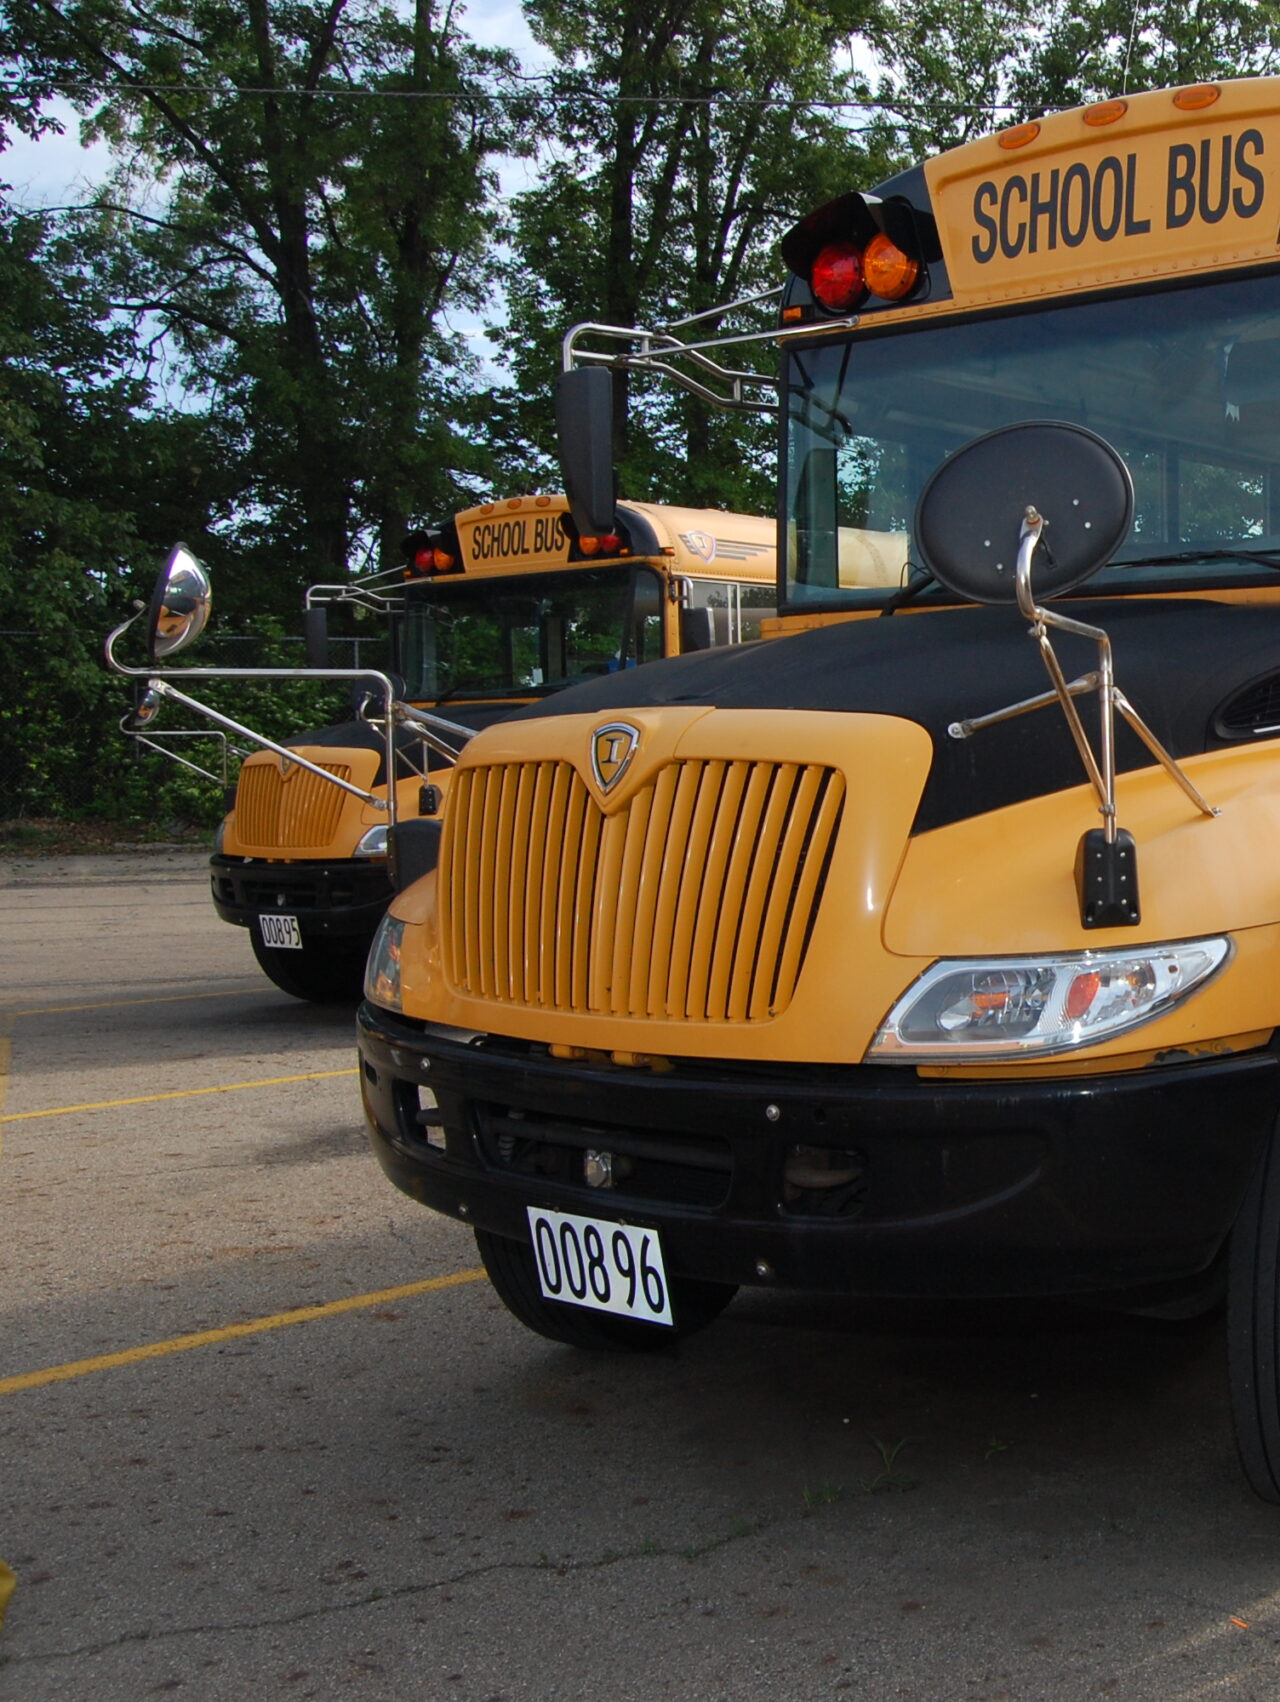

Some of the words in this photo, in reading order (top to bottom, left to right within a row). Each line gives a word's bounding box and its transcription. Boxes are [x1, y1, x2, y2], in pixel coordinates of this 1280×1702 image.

[971, 152, 1151, 264] SCHOOL
[1165, 128, 1265, 230] BUS
[472, 518, 530, 560] SCHOOL
[533, 515, 565, 553] BUS
[262, 916, 300, 947] 00895
[535, 1217, 665, 1314] 00896
